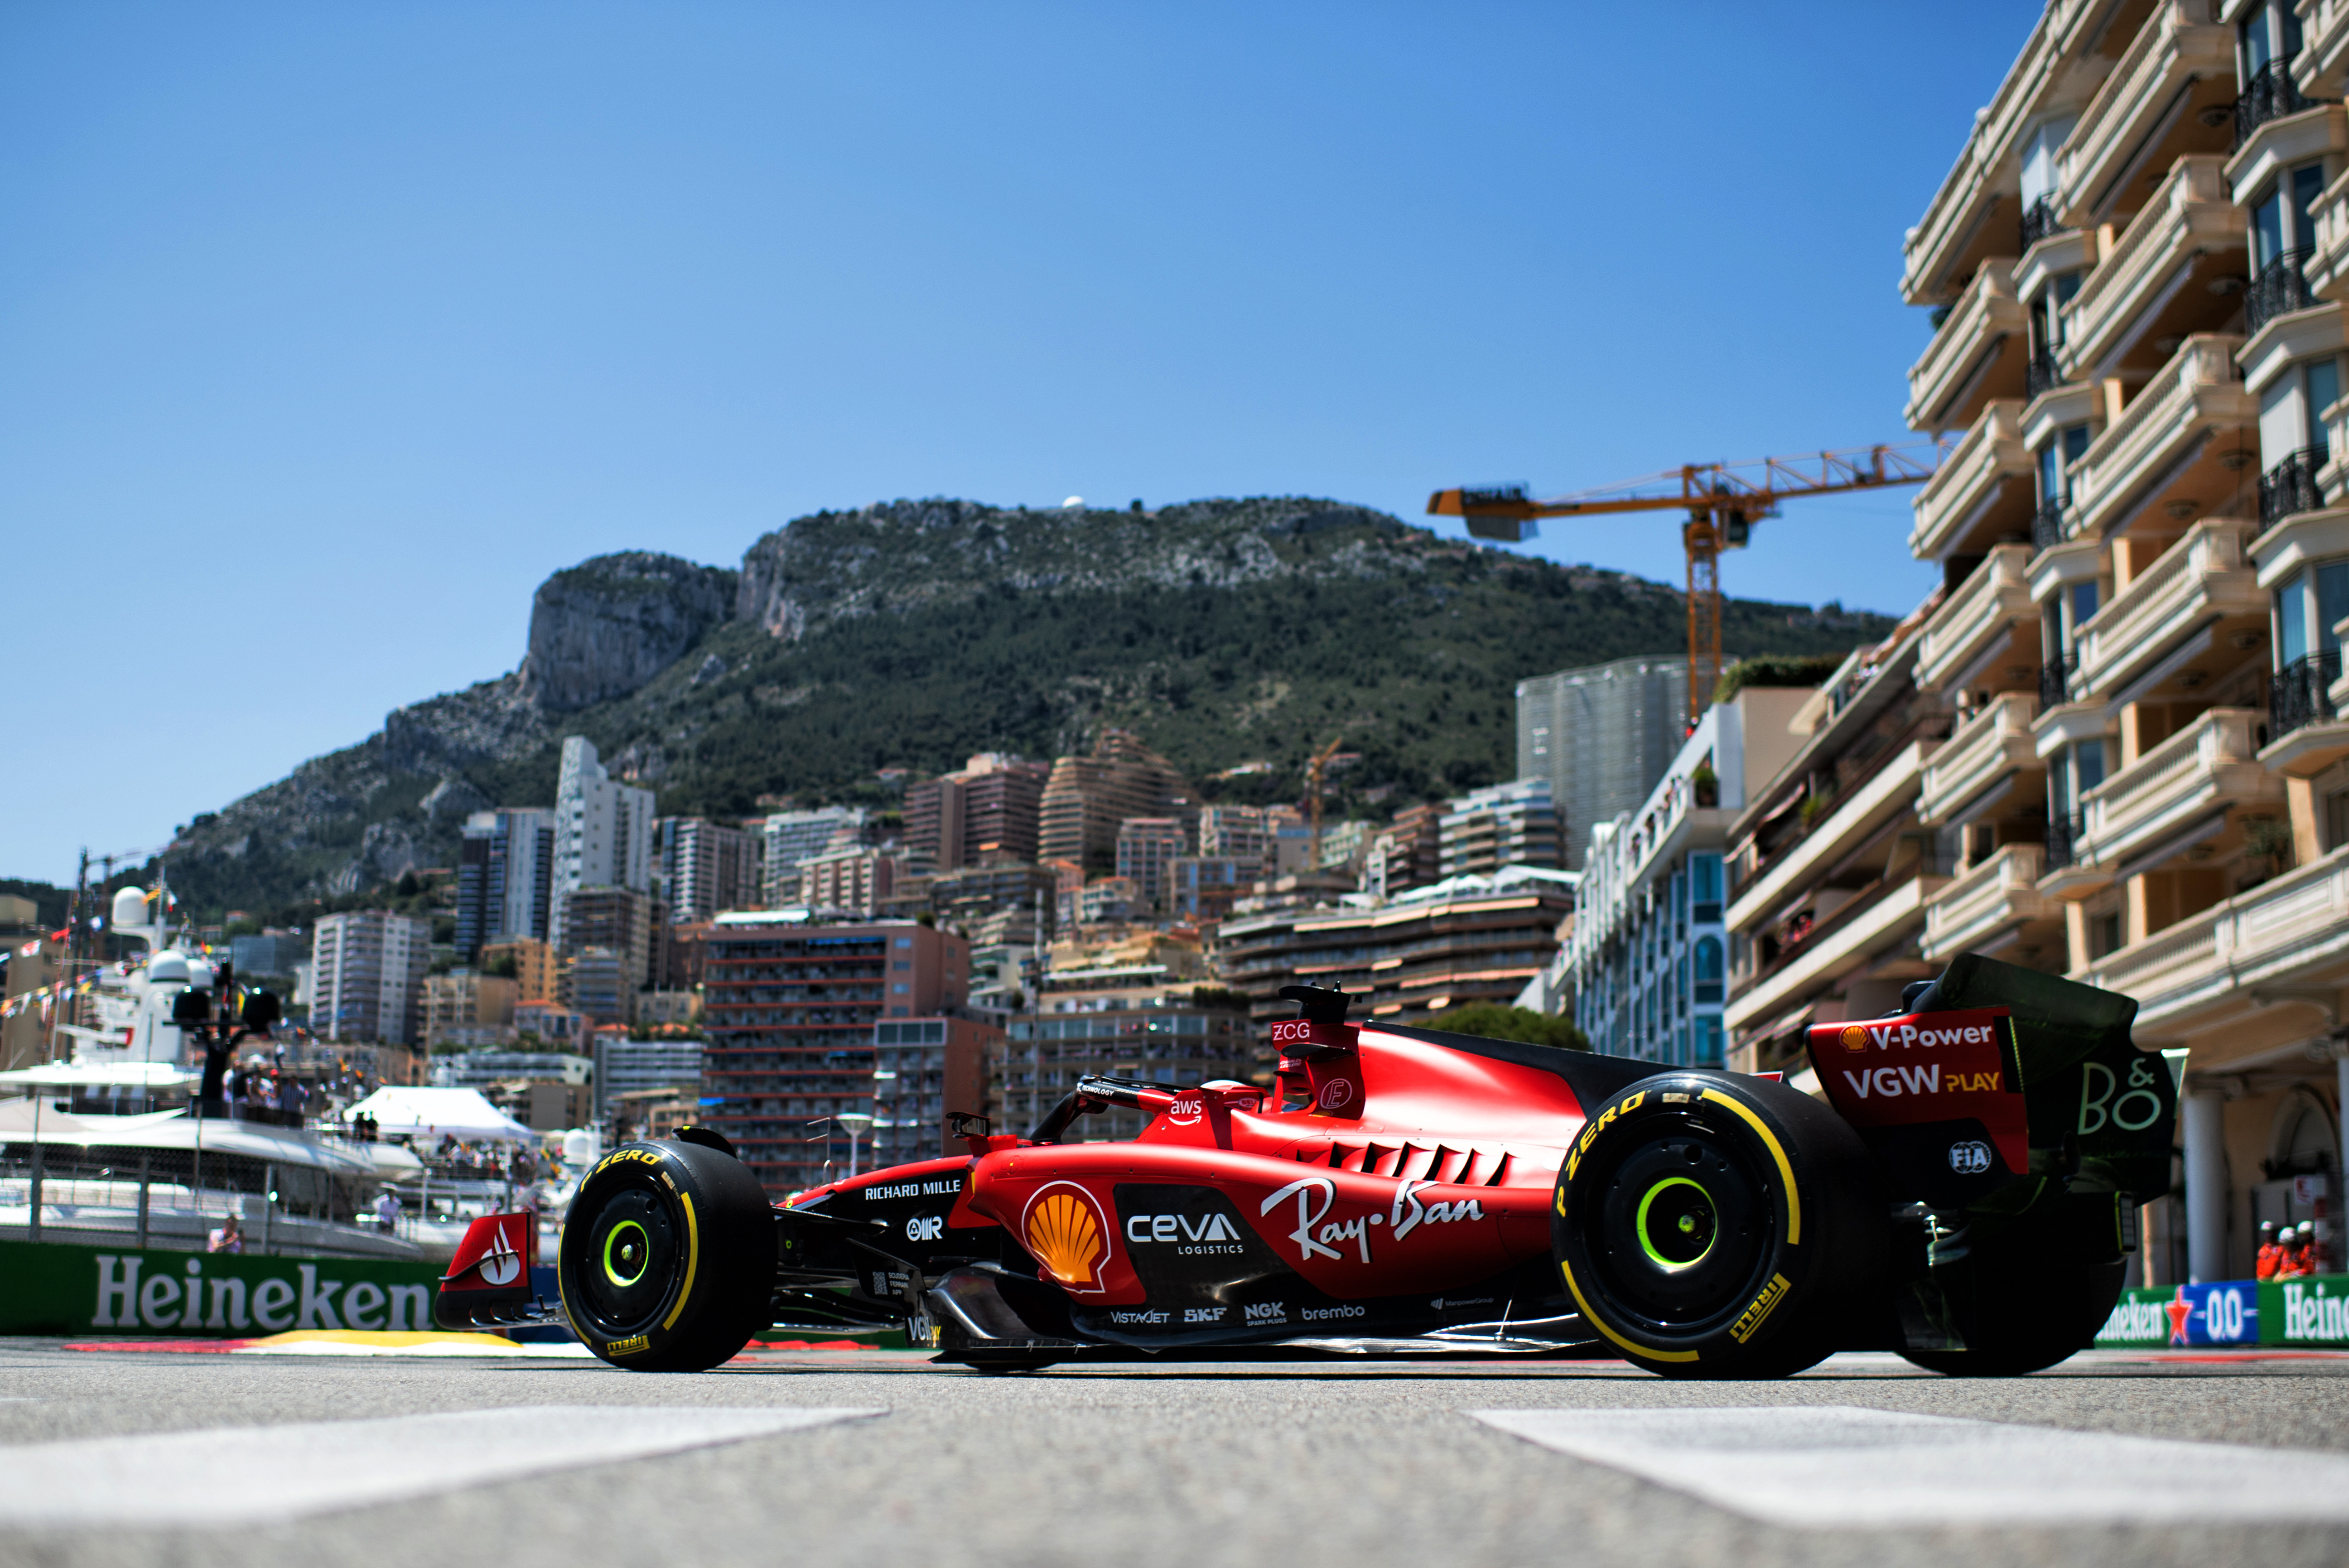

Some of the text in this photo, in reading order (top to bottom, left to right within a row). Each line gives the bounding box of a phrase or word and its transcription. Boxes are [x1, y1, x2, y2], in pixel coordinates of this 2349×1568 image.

[1870, 1024, 1992, 1051] V-Power
[1082, 1085, 1114, 1096] TECHNOLOGY
[1843, 1064, 1999, 1099] VGW PLAY
[1170, 1100, 1201, 1114] aws
[1557, 1090, 1646, 1217] P ZERO
[580, 1149, 662, 1193] P ZERO
[865, 1180, 960, 1200] RICHARD MILLE
[1178, 1245, 1243, 1254] LOGISTICS
[888, 1272, 910, 1281] SCUDERIA
[92, 1254, 435, 1330] Heineken
[1184, 1307, 1227, 1322] SKF
[1244, 1301, 1286, 1319] NGK
[1302, 1304, 1365, 1320] brembo
[1729, 1272, 1792, 1344] PIRELLI
[607, 1335, 651, 1356] PIRELLI
